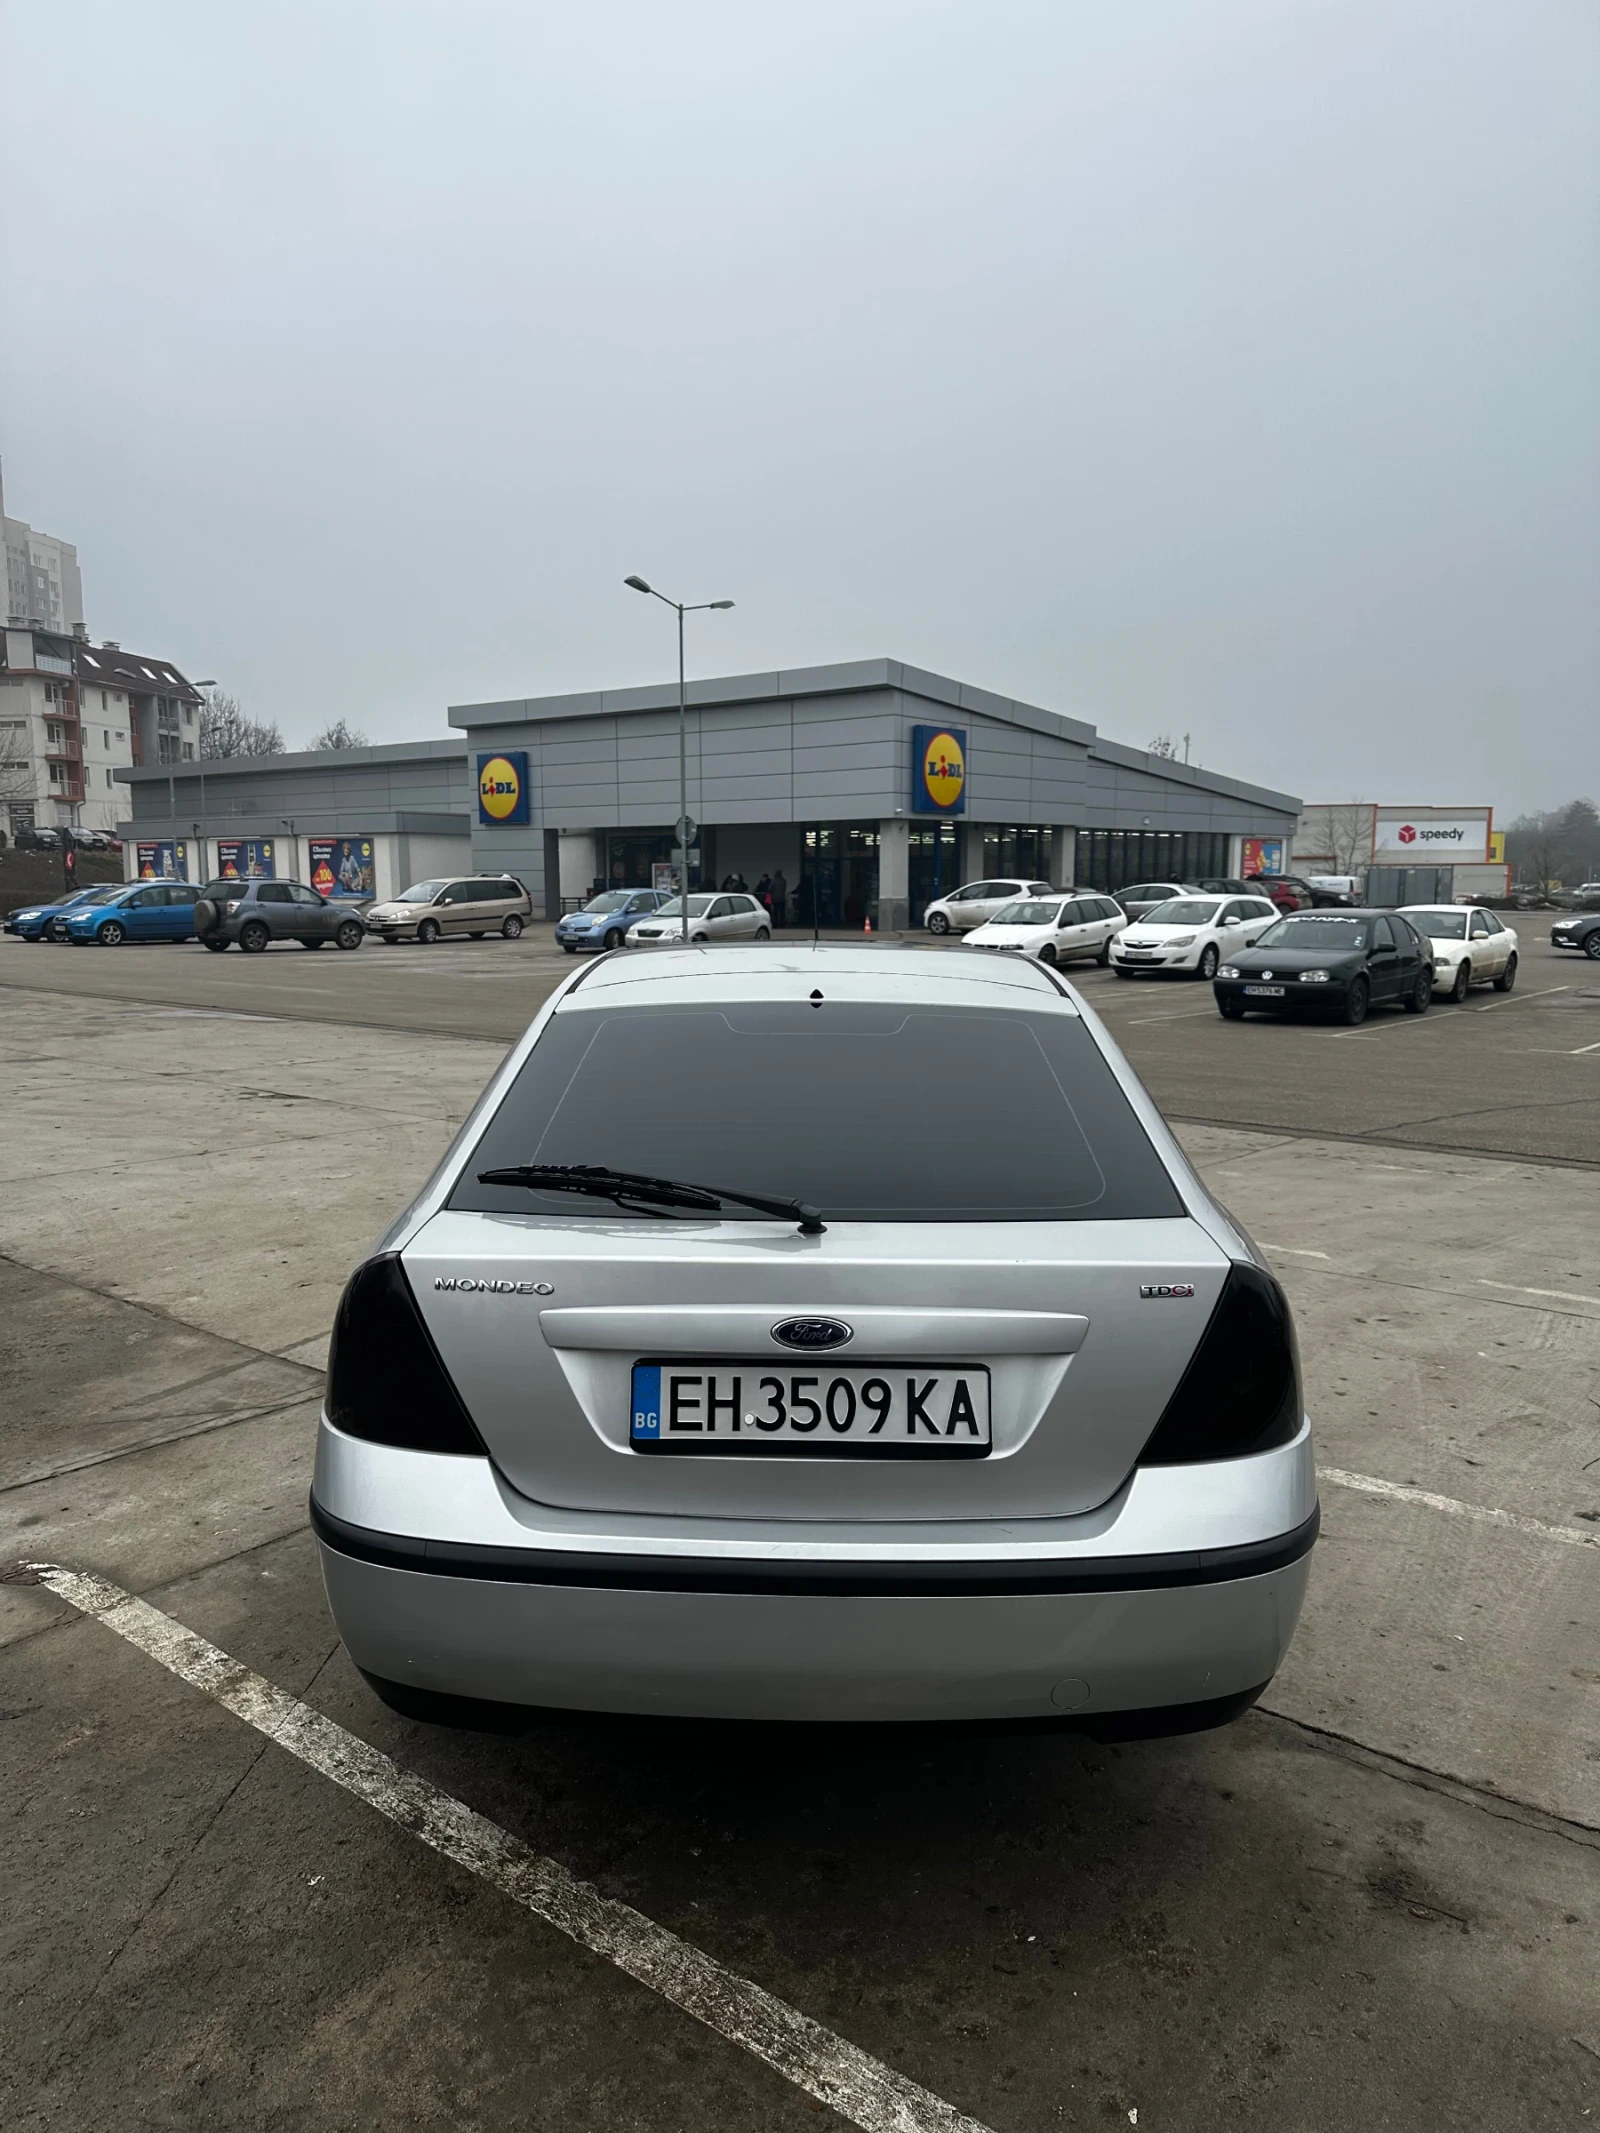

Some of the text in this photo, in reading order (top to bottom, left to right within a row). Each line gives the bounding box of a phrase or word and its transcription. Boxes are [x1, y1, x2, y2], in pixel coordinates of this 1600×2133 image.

[1420, 828, 1464, 841] speedy
[319, 869, 332, 882] 100
[434, 1277, 555, 1296] MONDEO
[1143, 1285, 1193, 1297] TDCi
[790, 1323, 833, 1341] Ford
[669, 1375, 980, 1436] EH 3509 KA
[634, 1412, 658, 1429] BG
